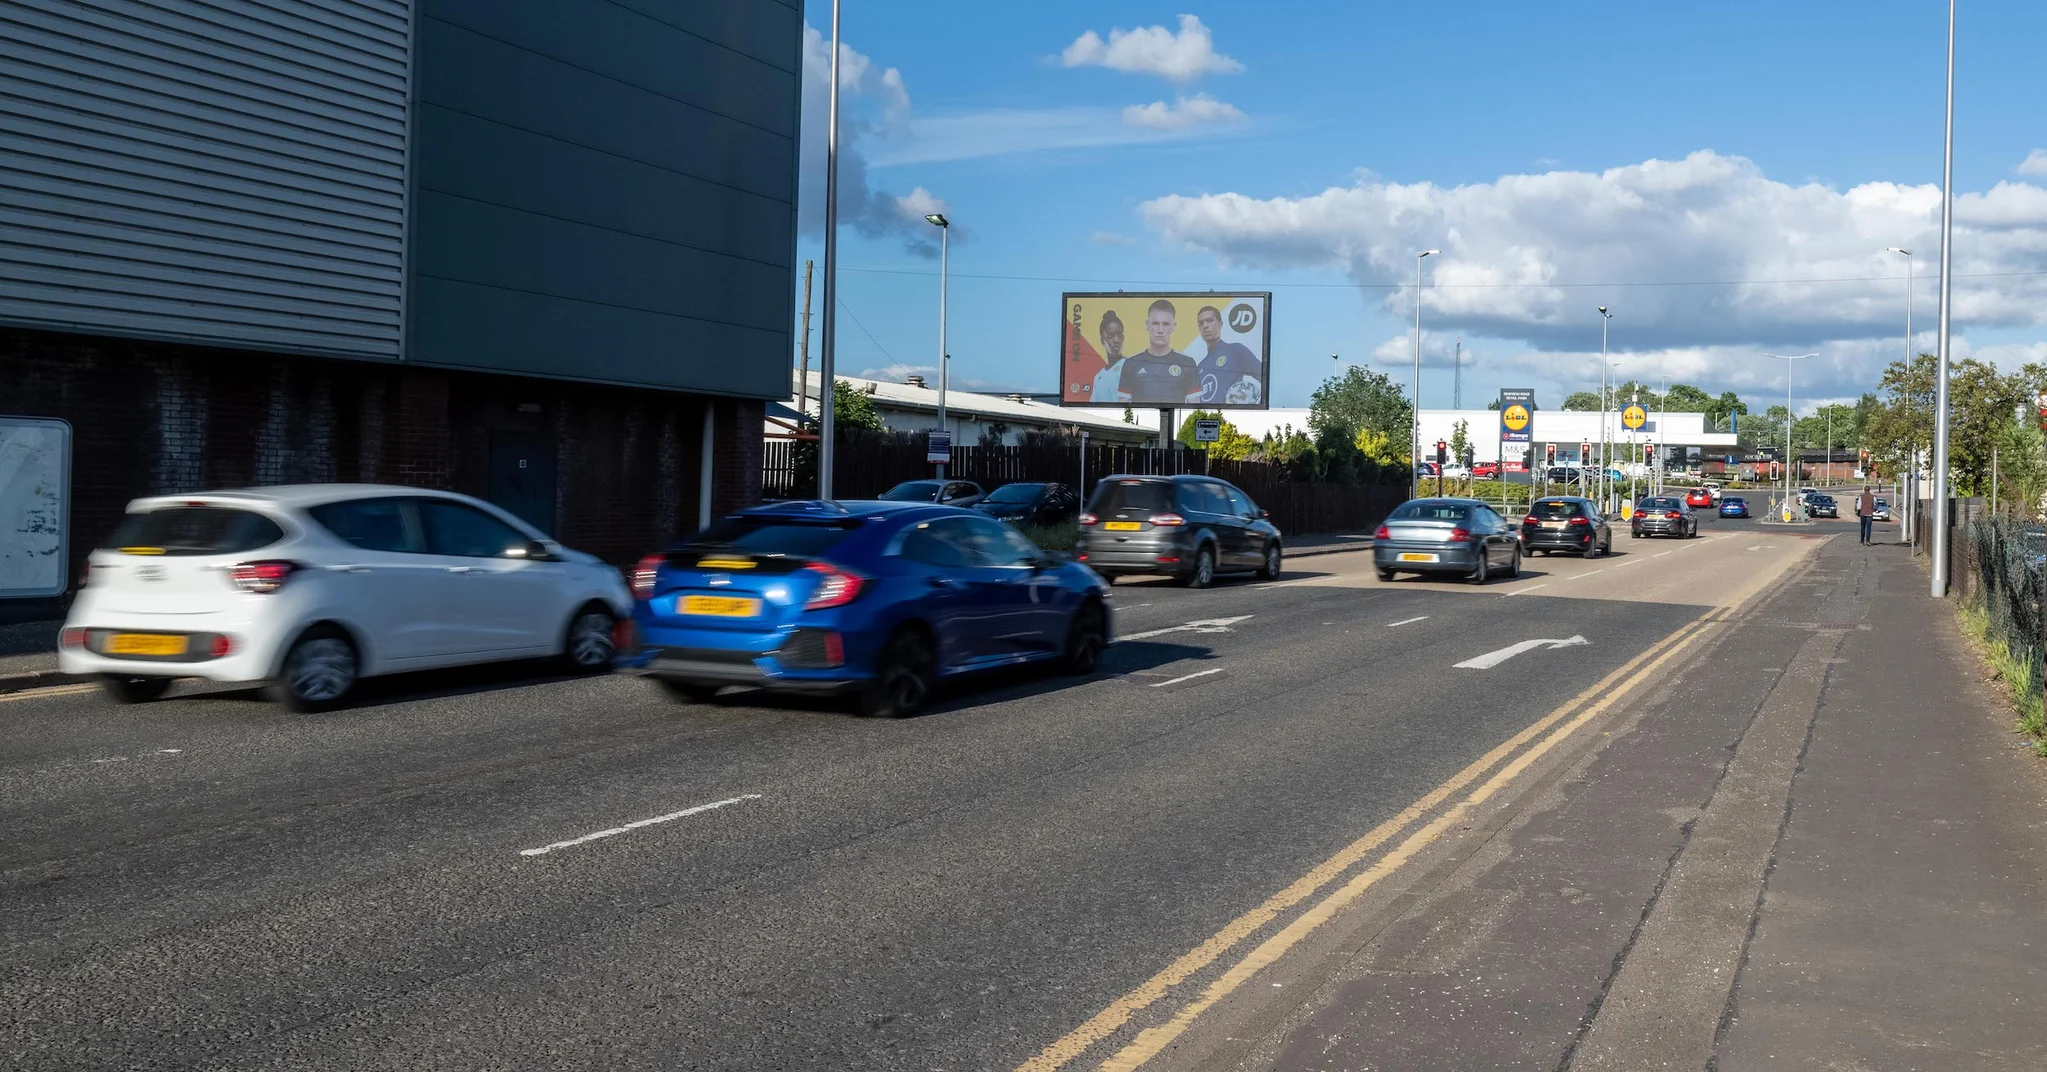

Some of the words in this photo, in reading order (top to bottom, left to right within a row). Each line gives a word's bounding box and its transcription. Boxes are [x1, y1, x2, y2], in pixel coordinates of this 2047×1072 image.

[1072, 304, 1082, 340] GAME
[1231, 310, 1254, 326] JD
[1072, 343, 1081, 362] ON
[1202, 381, 1214, 393] BT
[1505, 446, 1526, 454] M&S
